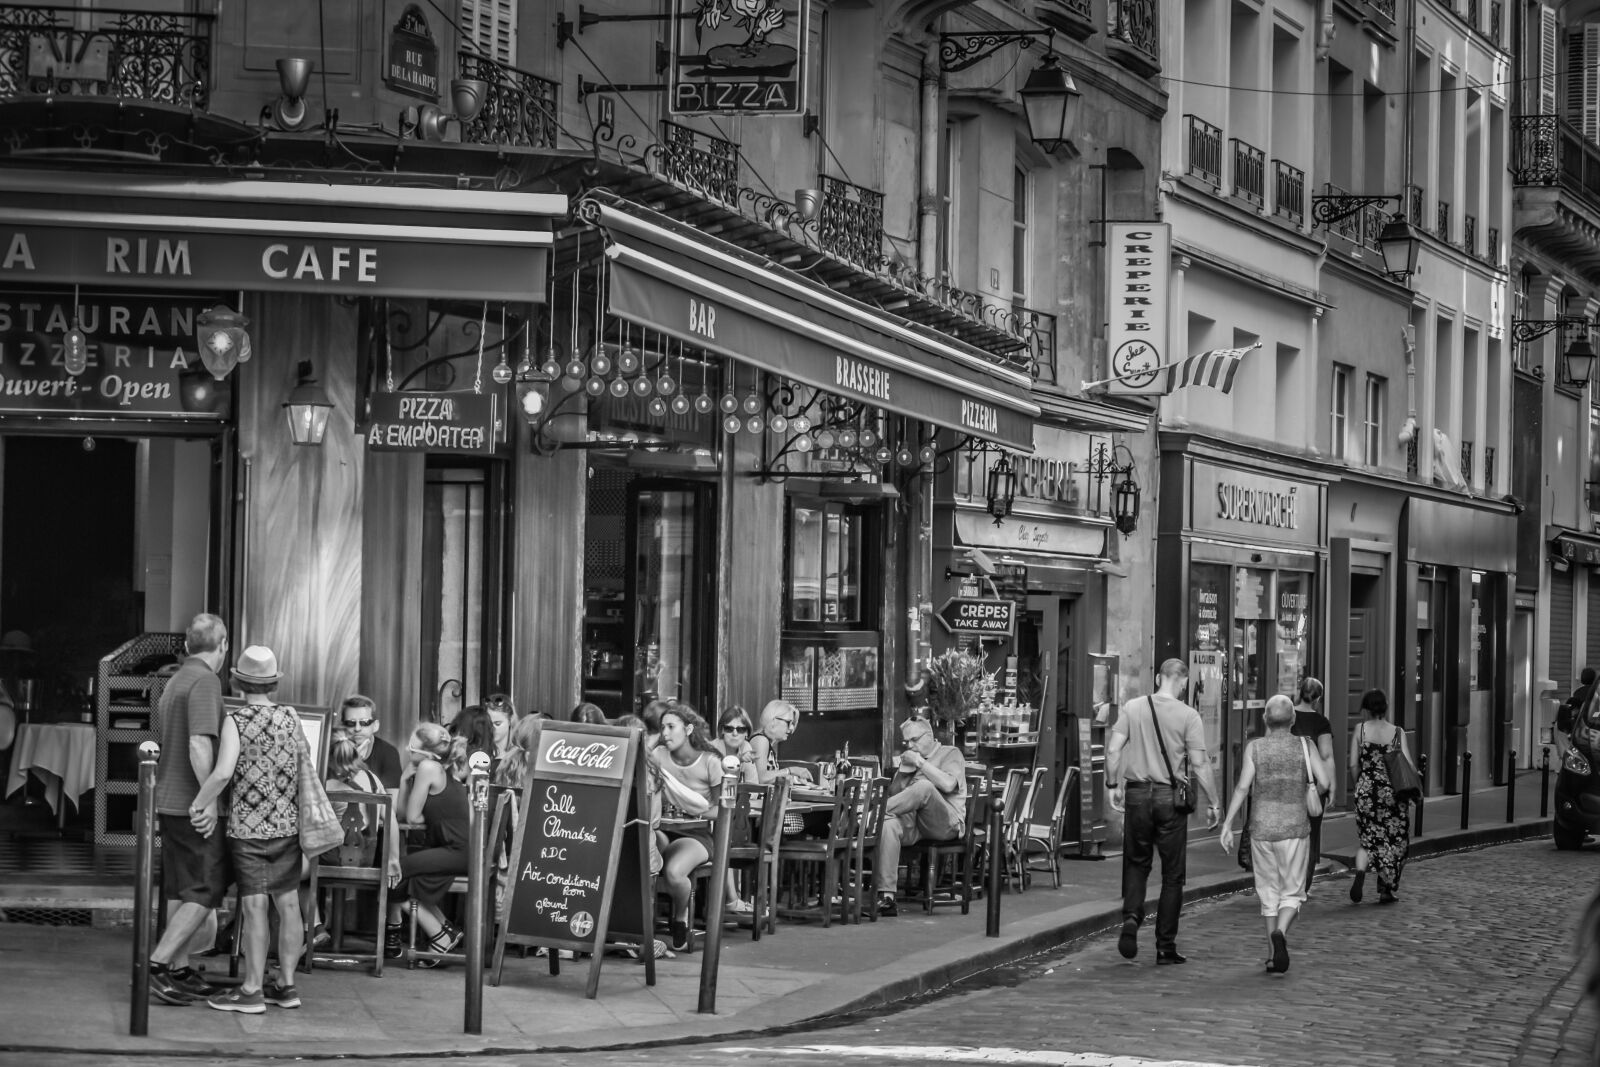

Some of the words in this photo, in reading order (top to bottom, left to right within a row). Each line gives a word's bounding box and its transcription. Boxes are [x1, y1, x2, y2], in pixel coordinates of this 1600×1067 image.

[406, 50, 423, 67] RUE
[391, 64, 401, 79] DE
[402, 67, 411, 82] LA
[412, 71, 437, 92] HARPE
[676, 83, 788, 108] PIZZA
[2, 233, 35, 270] A
[106, 237, 192, 275] RIM
[261, 244, 377, 282] CAFE
[1123, 231, 1153, 332] CREPERIE
[689, 298, 716, 339] BAR
[100, 374, 171, 406] Open
[836, 355, 890, 401] BRASSERIE
[398, 397, 453, 421] PIZZA
[961, 399, 998, 434] PIZZERIA
[386, 420, 484, 449] EMPORTER
[954, 618, 979, 628] TAKE
[981, 620, 1008, 629] AWAY
[960, 603, 1008, 619] CRÊPES
[545, 738, 620, 770] Coca-Cola
[543, 785, 577, 815] Salle
[540, 846, 568, 861] RDC
